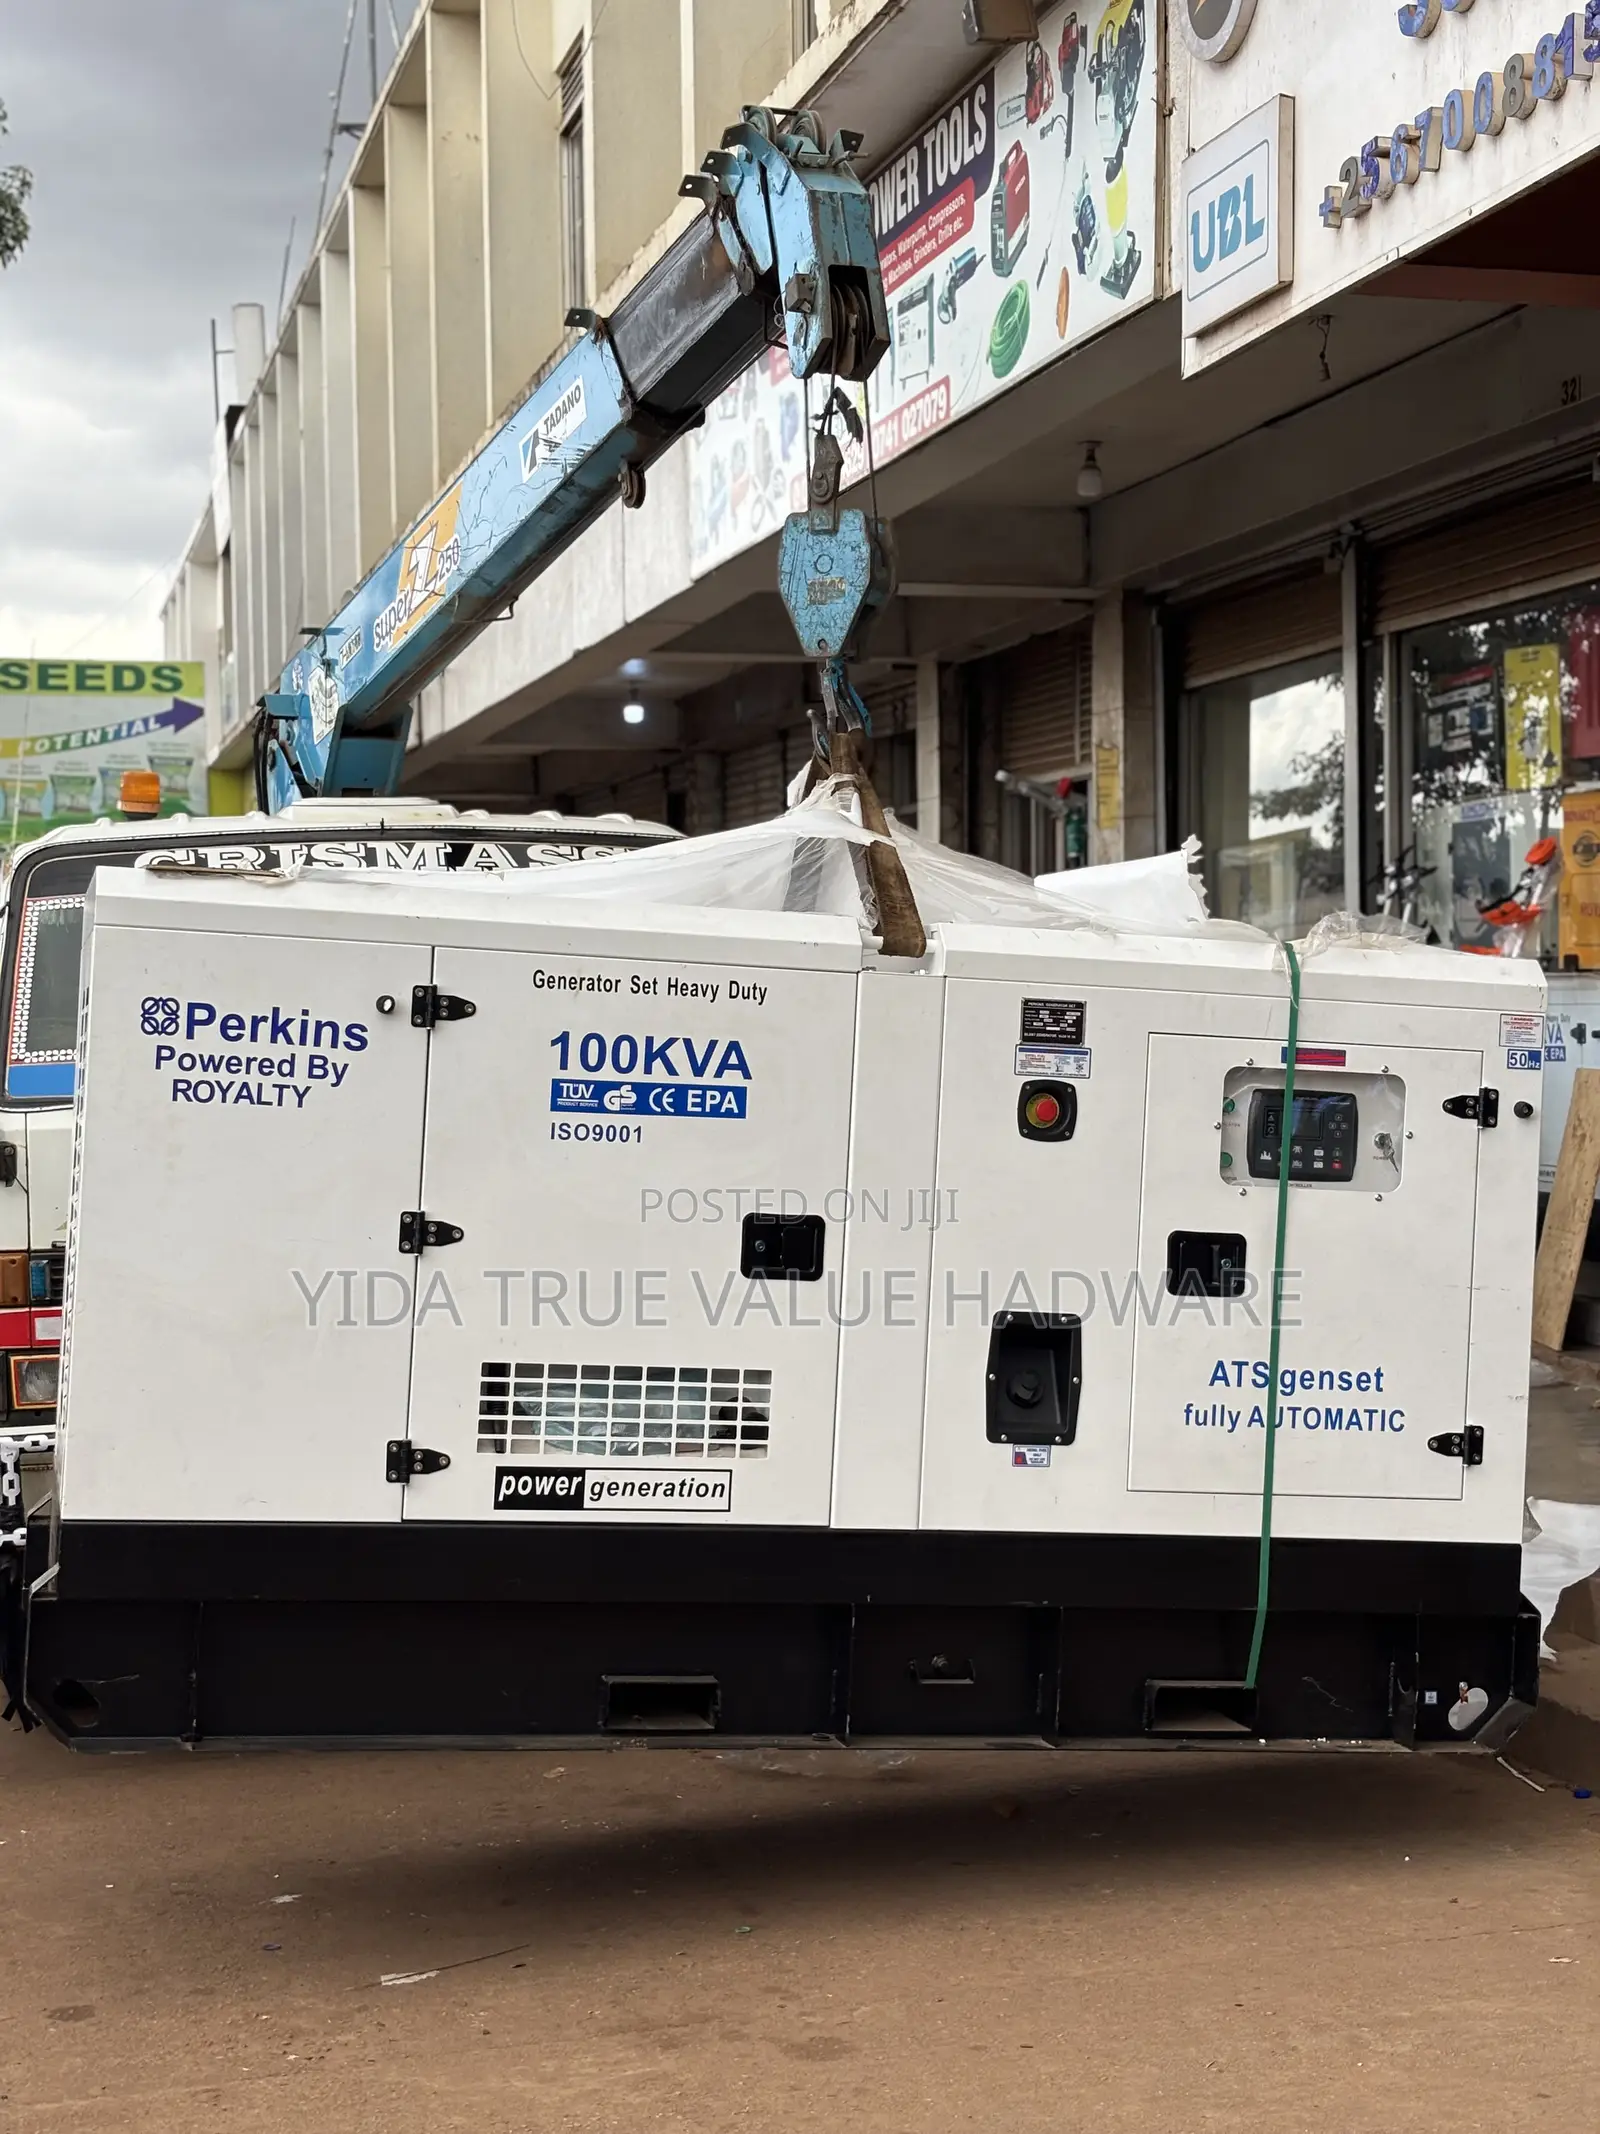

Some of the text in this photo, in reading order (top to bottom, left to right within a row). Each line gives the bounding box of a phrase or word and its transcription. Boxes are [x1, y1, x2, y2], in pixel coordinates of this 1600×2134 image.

[868, 83, 987, 241] OWER TOOLS
[1190, 173, 1266, 273] UBL
[543, 384, 581, 435] TADANO
[902, 384, 948, 442] 027079
[438, 538, 461, 579] 250
[0, 661, 183, 693] SEEDS
[18, 716, 162, 756] POTENTIAL
[532, 969, 768, 1005] Generator Set Heavy Duty
[186, 1002, 369, 1051] Perkins
[155, 1045, 350, 1087] Powered By
[550, 1031, 753, 1080] 100KVA
[1509, 1052, 1540, 1068] 50 Hz
[1550, 1048, 1565, 1060] EPA
[172, 1079, 312, 1108] ROYALTY
[559, 1083, 595, 1099] TÜV
[649, 1087, 676, 1112] CE
[687, 1089, 739, 1113] EPA
[550, 1122, 643, 1143] ISO9001
[1208, 1360, 1384, 1396] ATS genset
[1184, 1403, 1241, 1433] fully
[498, 1474, 726, 1501] power generation
